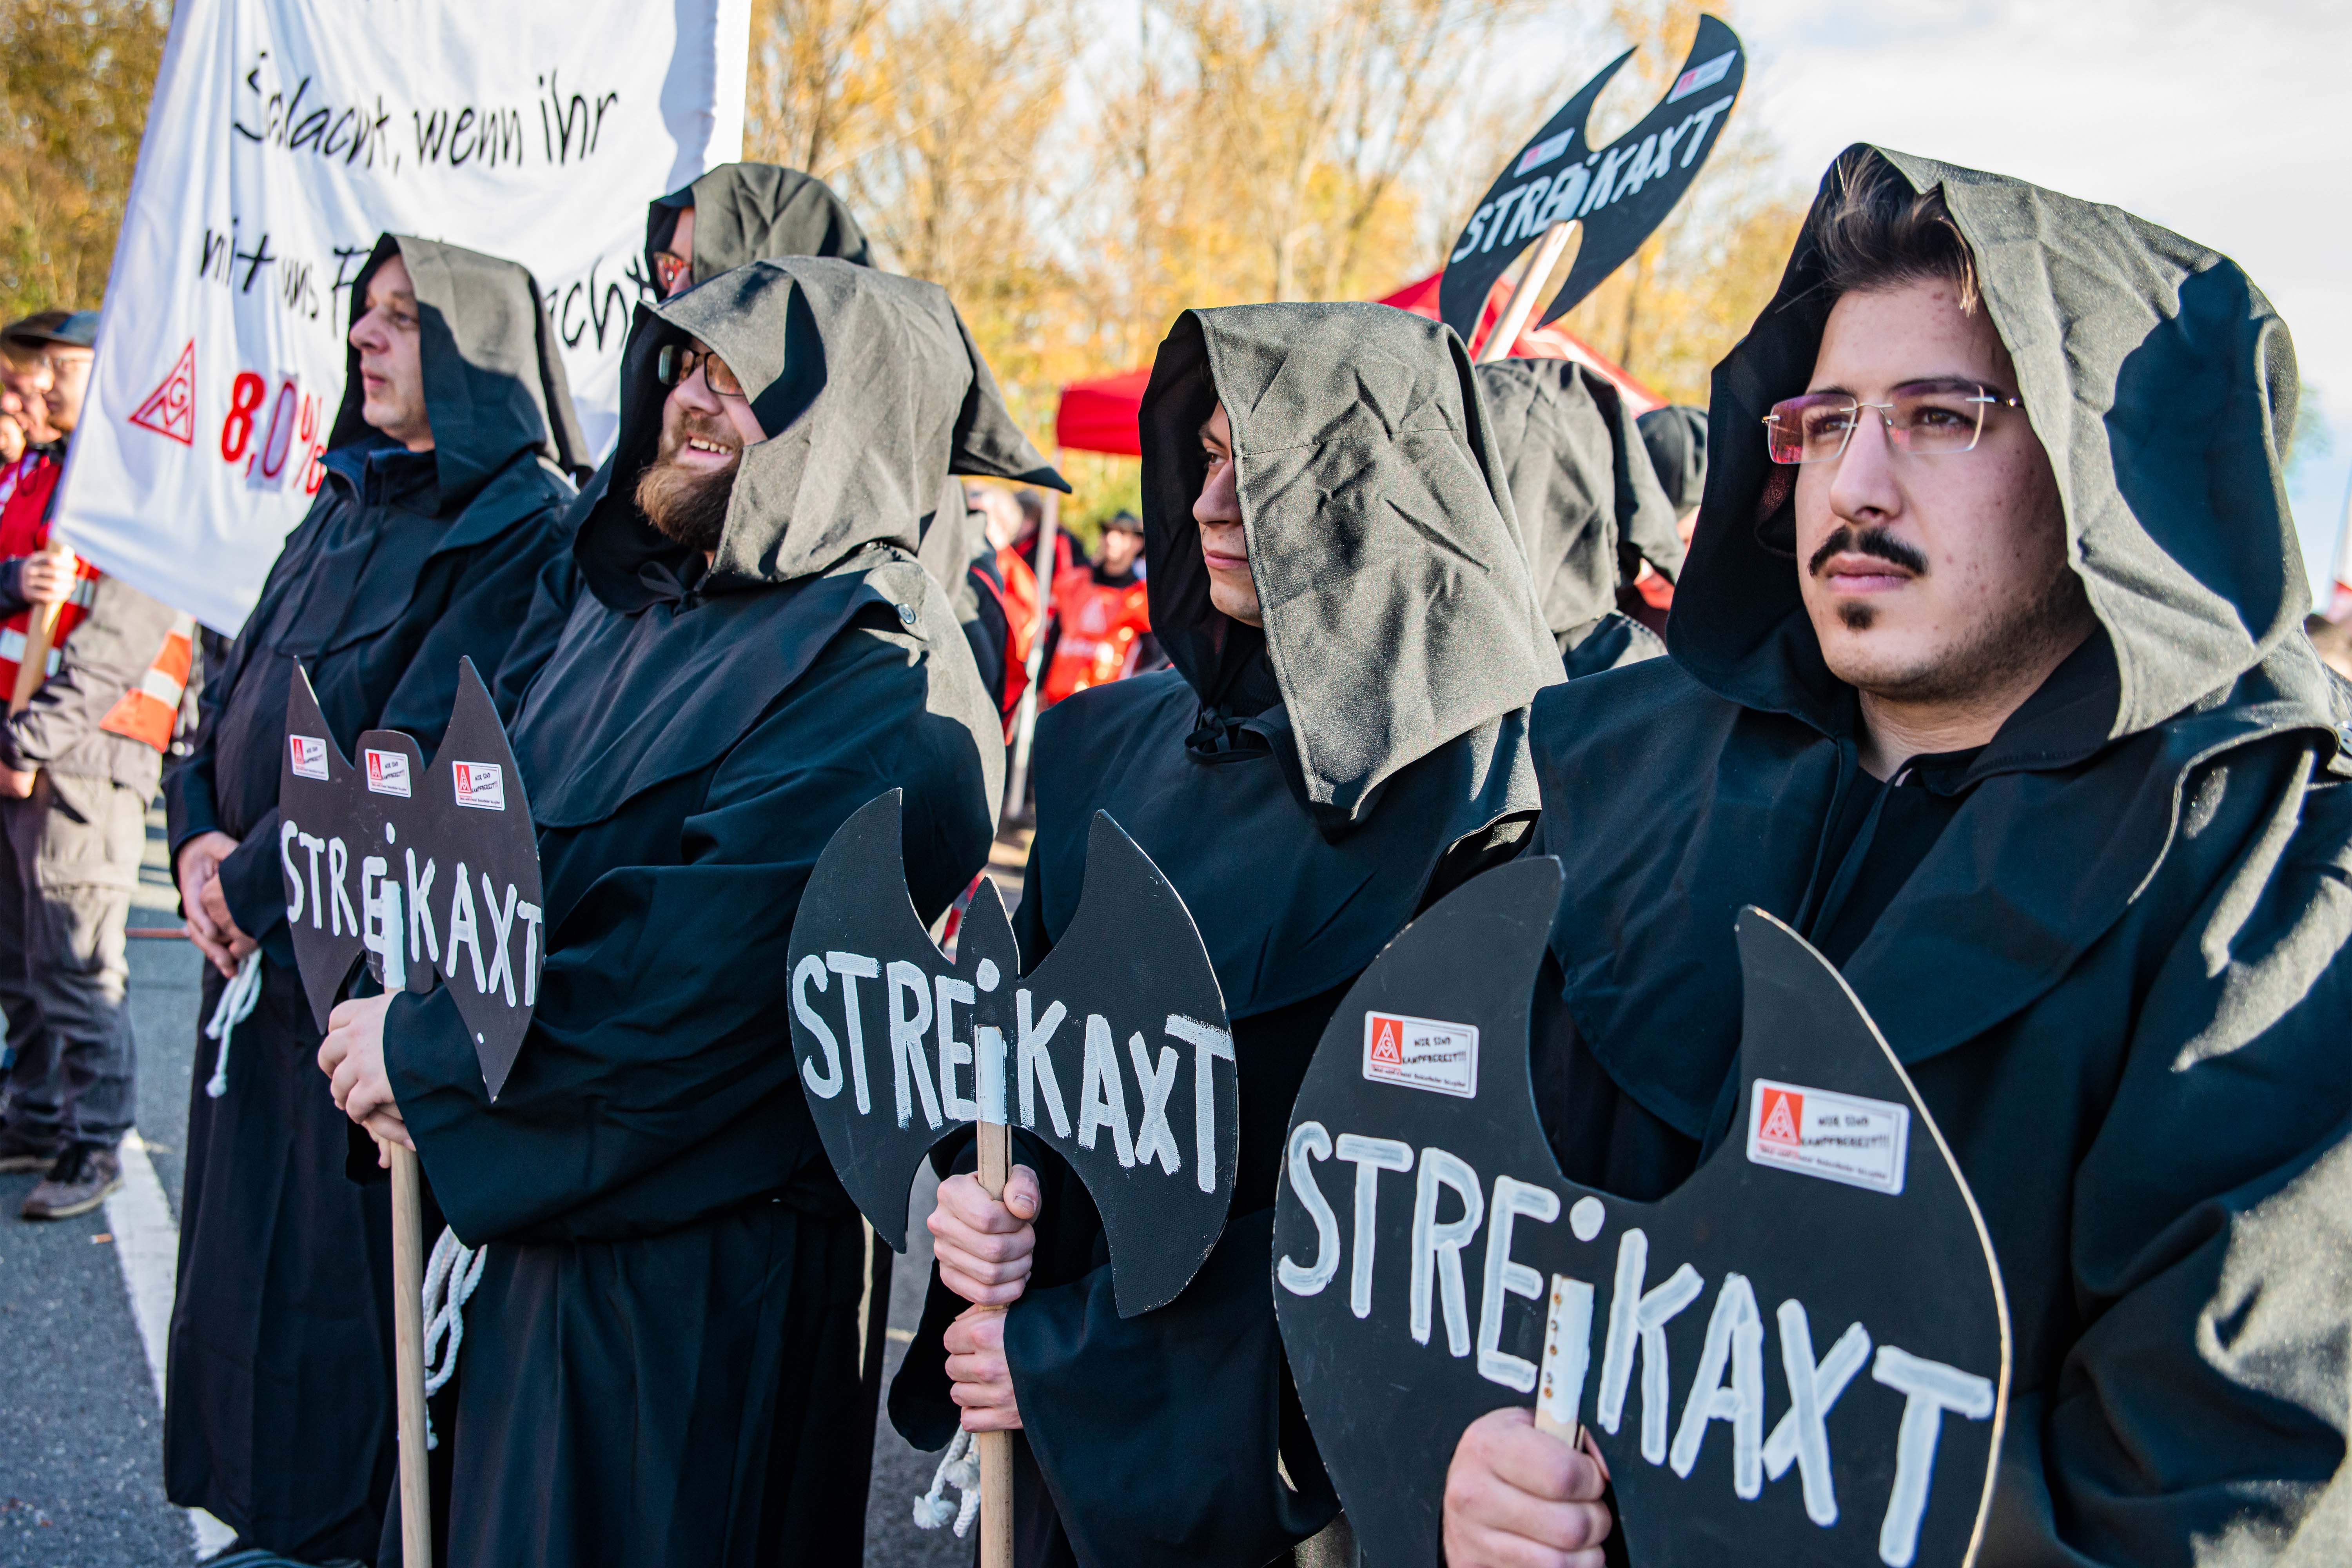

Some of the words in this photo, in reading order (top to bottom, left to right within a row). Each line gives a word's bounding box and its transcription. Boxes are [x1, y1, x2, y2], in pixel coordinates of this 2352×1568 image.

[414, 107, 522, 168] wenn
[539, 68, 617, 165] ihr
[1414, 1038, 1430, 1047] WIR
